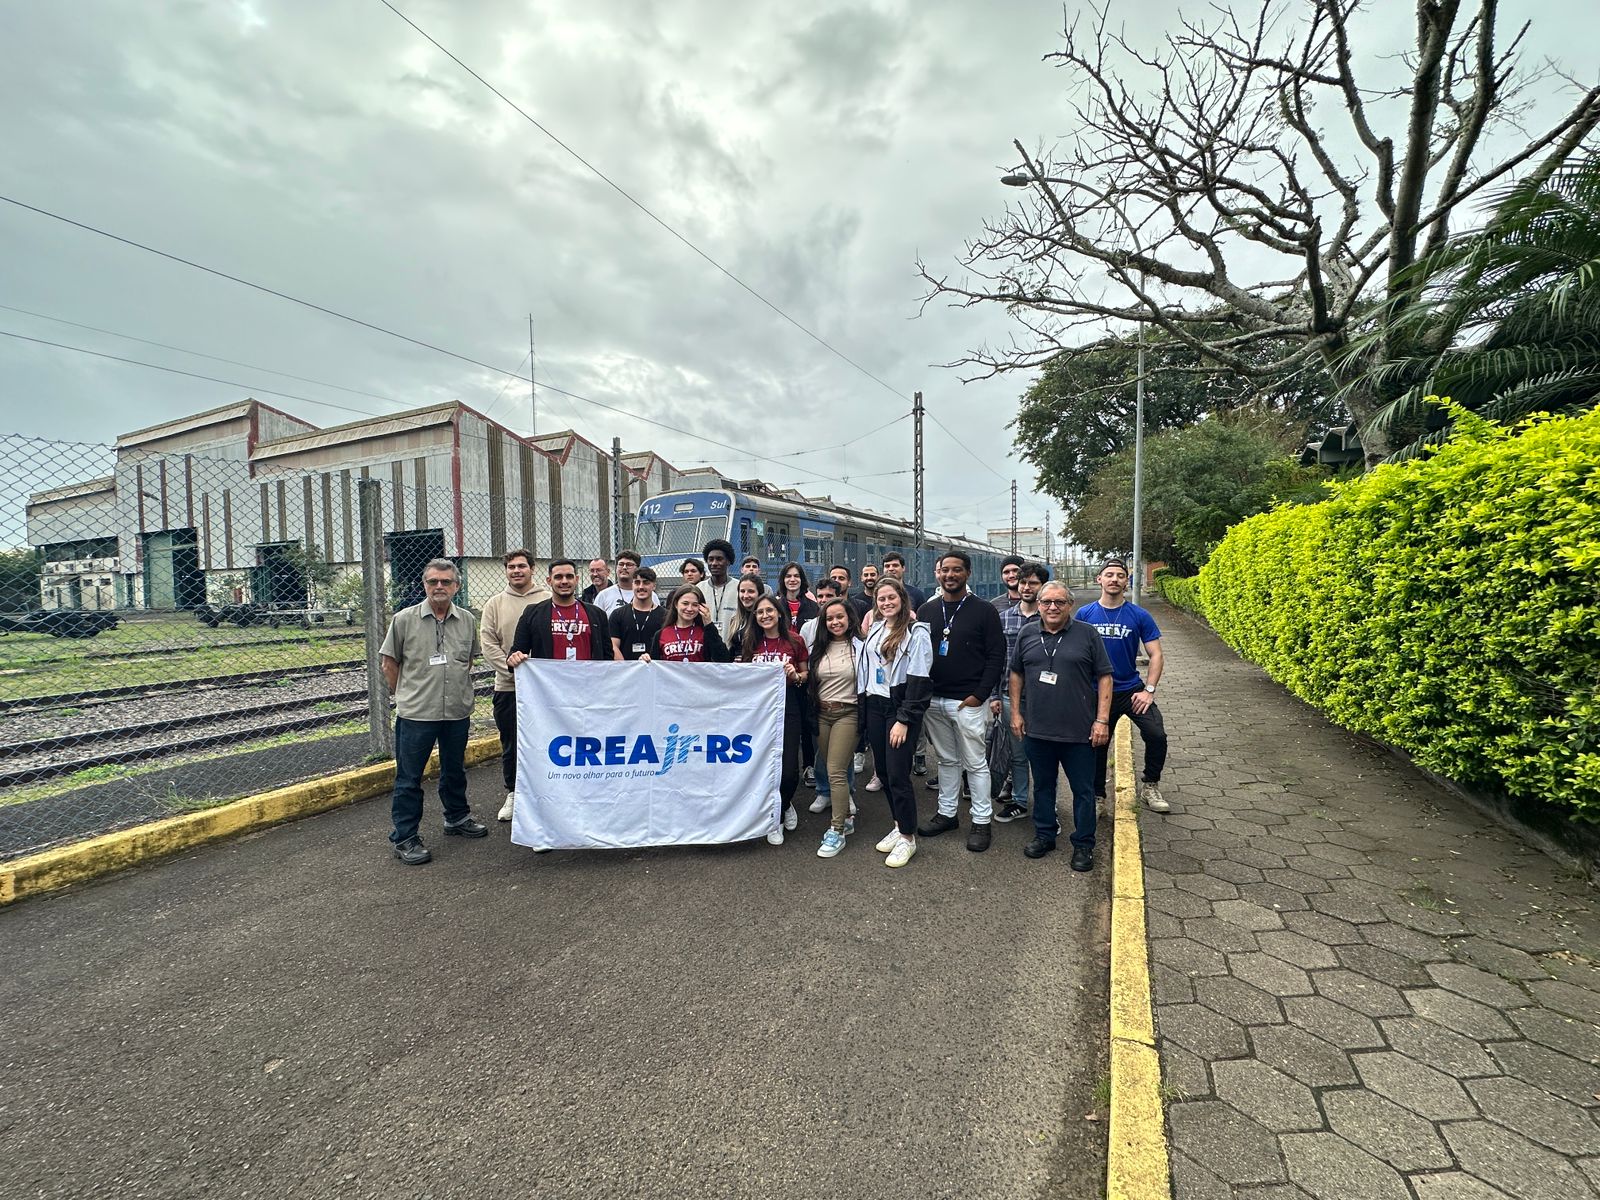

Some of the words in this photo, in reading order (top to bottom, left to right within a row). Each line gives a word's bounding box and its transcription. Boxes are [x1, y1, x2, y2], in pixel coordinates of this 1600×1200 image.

[643, 504, 661, 515] 112
[710, 500, 727, 510] Sul
[1095, 625, 1133, 639] REAjr
[547, 771, 561, 780] Um
[562, 772, 582, 780] novo
[583, 770, 603, 780] olhar
[604, 771, 623, 781] para
[631, 769, 655, 779] futuro
